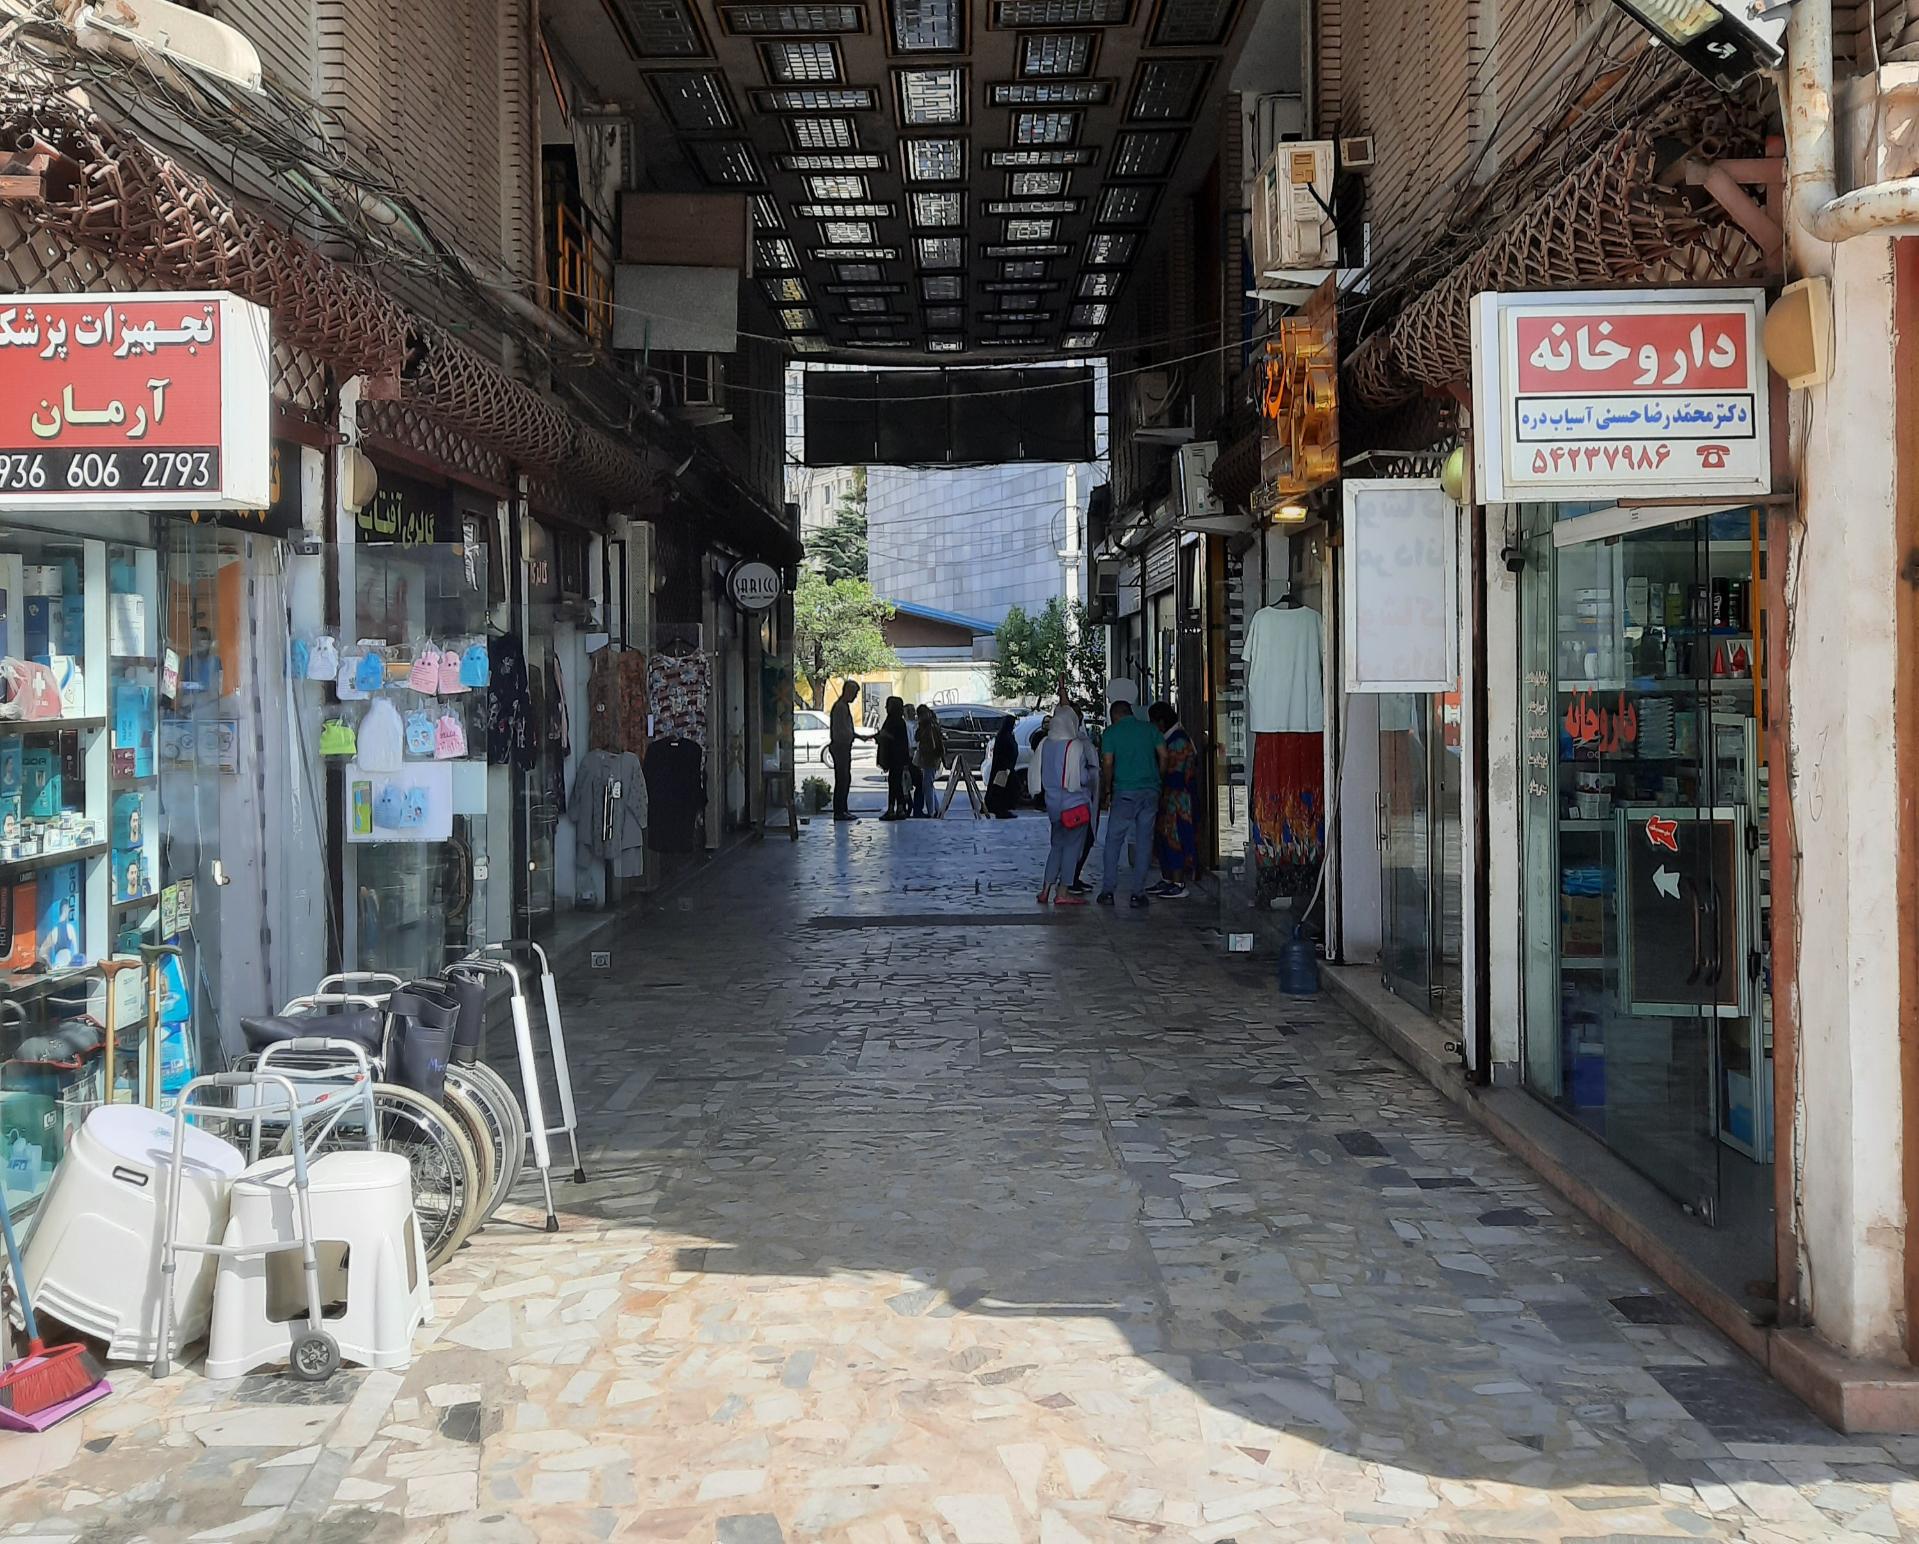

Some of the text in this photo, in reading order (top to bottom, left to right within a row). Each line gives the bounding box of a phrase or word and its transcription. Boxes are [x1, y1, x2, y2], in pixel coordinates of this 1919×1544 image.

[0, 307, 68, 359] پزشک
[1529, 320, 1737, 386] داروخانه
[31, 377, 171, 439] آرمان
[1521, 412, 1548, 431] دره
[1549, 406, 1594, 431] آسیاب
[1596, 407, 1642, 431] حسنی
[1644, 402, 1671, 430] رضا
[1711, 403, 1747, 430] دکتر
[67, 453, 120, 488] 606
[141, 452, 210, 488] 2793
[1531, 443, 1671, 474] ۵۴۲۳۷۹۸۶
[357, 490, 435, 550] گالری آفتاب
[735, 577, 779, 594] SARICCI
[1564, 686, 1637, 753] داروخانه
